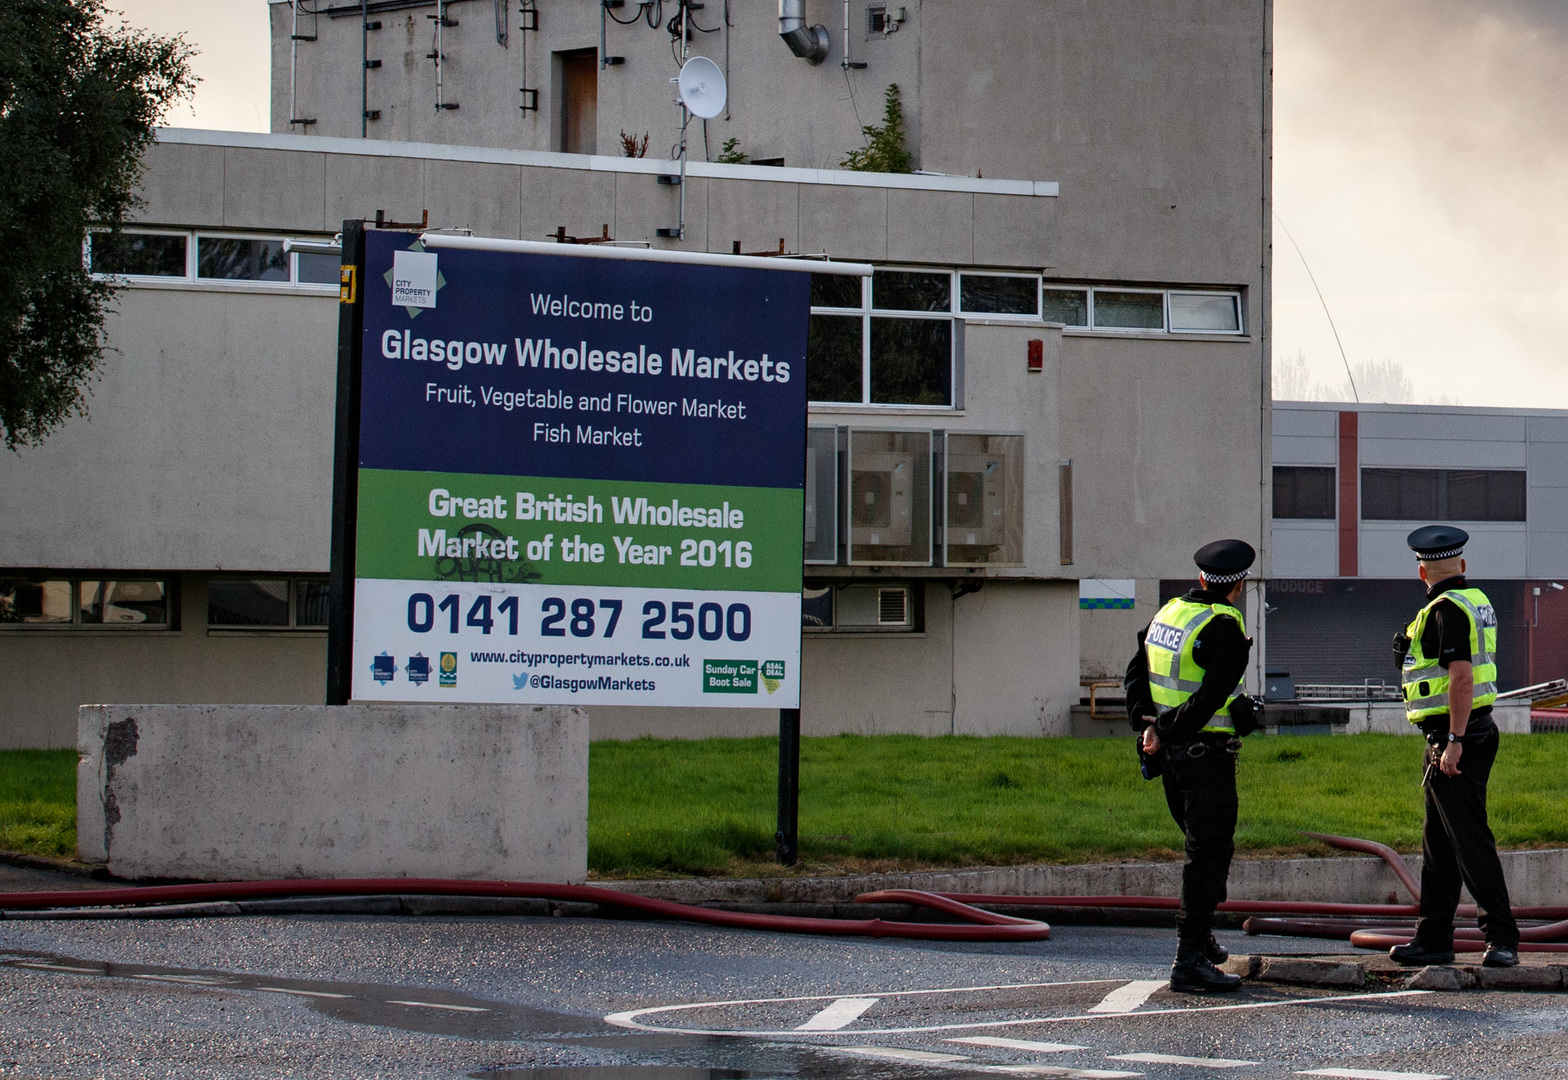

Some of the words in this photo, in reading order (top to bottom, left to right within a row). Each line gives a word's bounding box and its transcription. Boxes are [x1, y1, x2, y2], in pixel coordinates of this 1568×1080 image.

[395, 280, 412, 288] CITY
[395, 287, 432, 296] PROPERTY
[395, 295, 427, 304] MARKETS
[530, 292, 625, 320] Welcome
[630, 300, 653, 322] to
[381, 329, 507, 370] Glasgow
[514, 337, 663, 375] Wholesale
[670, 348, 790, 383] Markets
[425, 382, 477, 408] Fruit,
[480, 385, 573, 411] Vegetable
[578, 393, 611, 412] and
[617, 394, 677, 415] Flower
[682, 398, 747, 420] Market
[533, 423, 570, 443] Fish
[576, 425, 642, 447] Market
[428, 488, 507, 519] Great
[515, 492, 603, 523] British
[611, 496, 744, 529] Wholesale
[417, 528, 519, 560] Market
[527, 533, 554, 561] of
[561, 535, 605, 563] the
[612, 536, 672, 565] Year
[680, 538, 752, 569] 2016
[407, 592, 519, 635] 0141
[540, 597, 623, 638] 287
[641, 600, 752, 642] 2500
[1148, 622, 1182, 650] POLICE
[470, 650, 691, 668] www.citypropertymarkets.co.uk
[705, 664, 738, 676] Sunday
[739, 665, 756, 674] Car
[530, 674, 656, 693] @GlasgowMarkets
[709, 677, 730, 686] Boot
[732, 677, 752, 687] Sale
